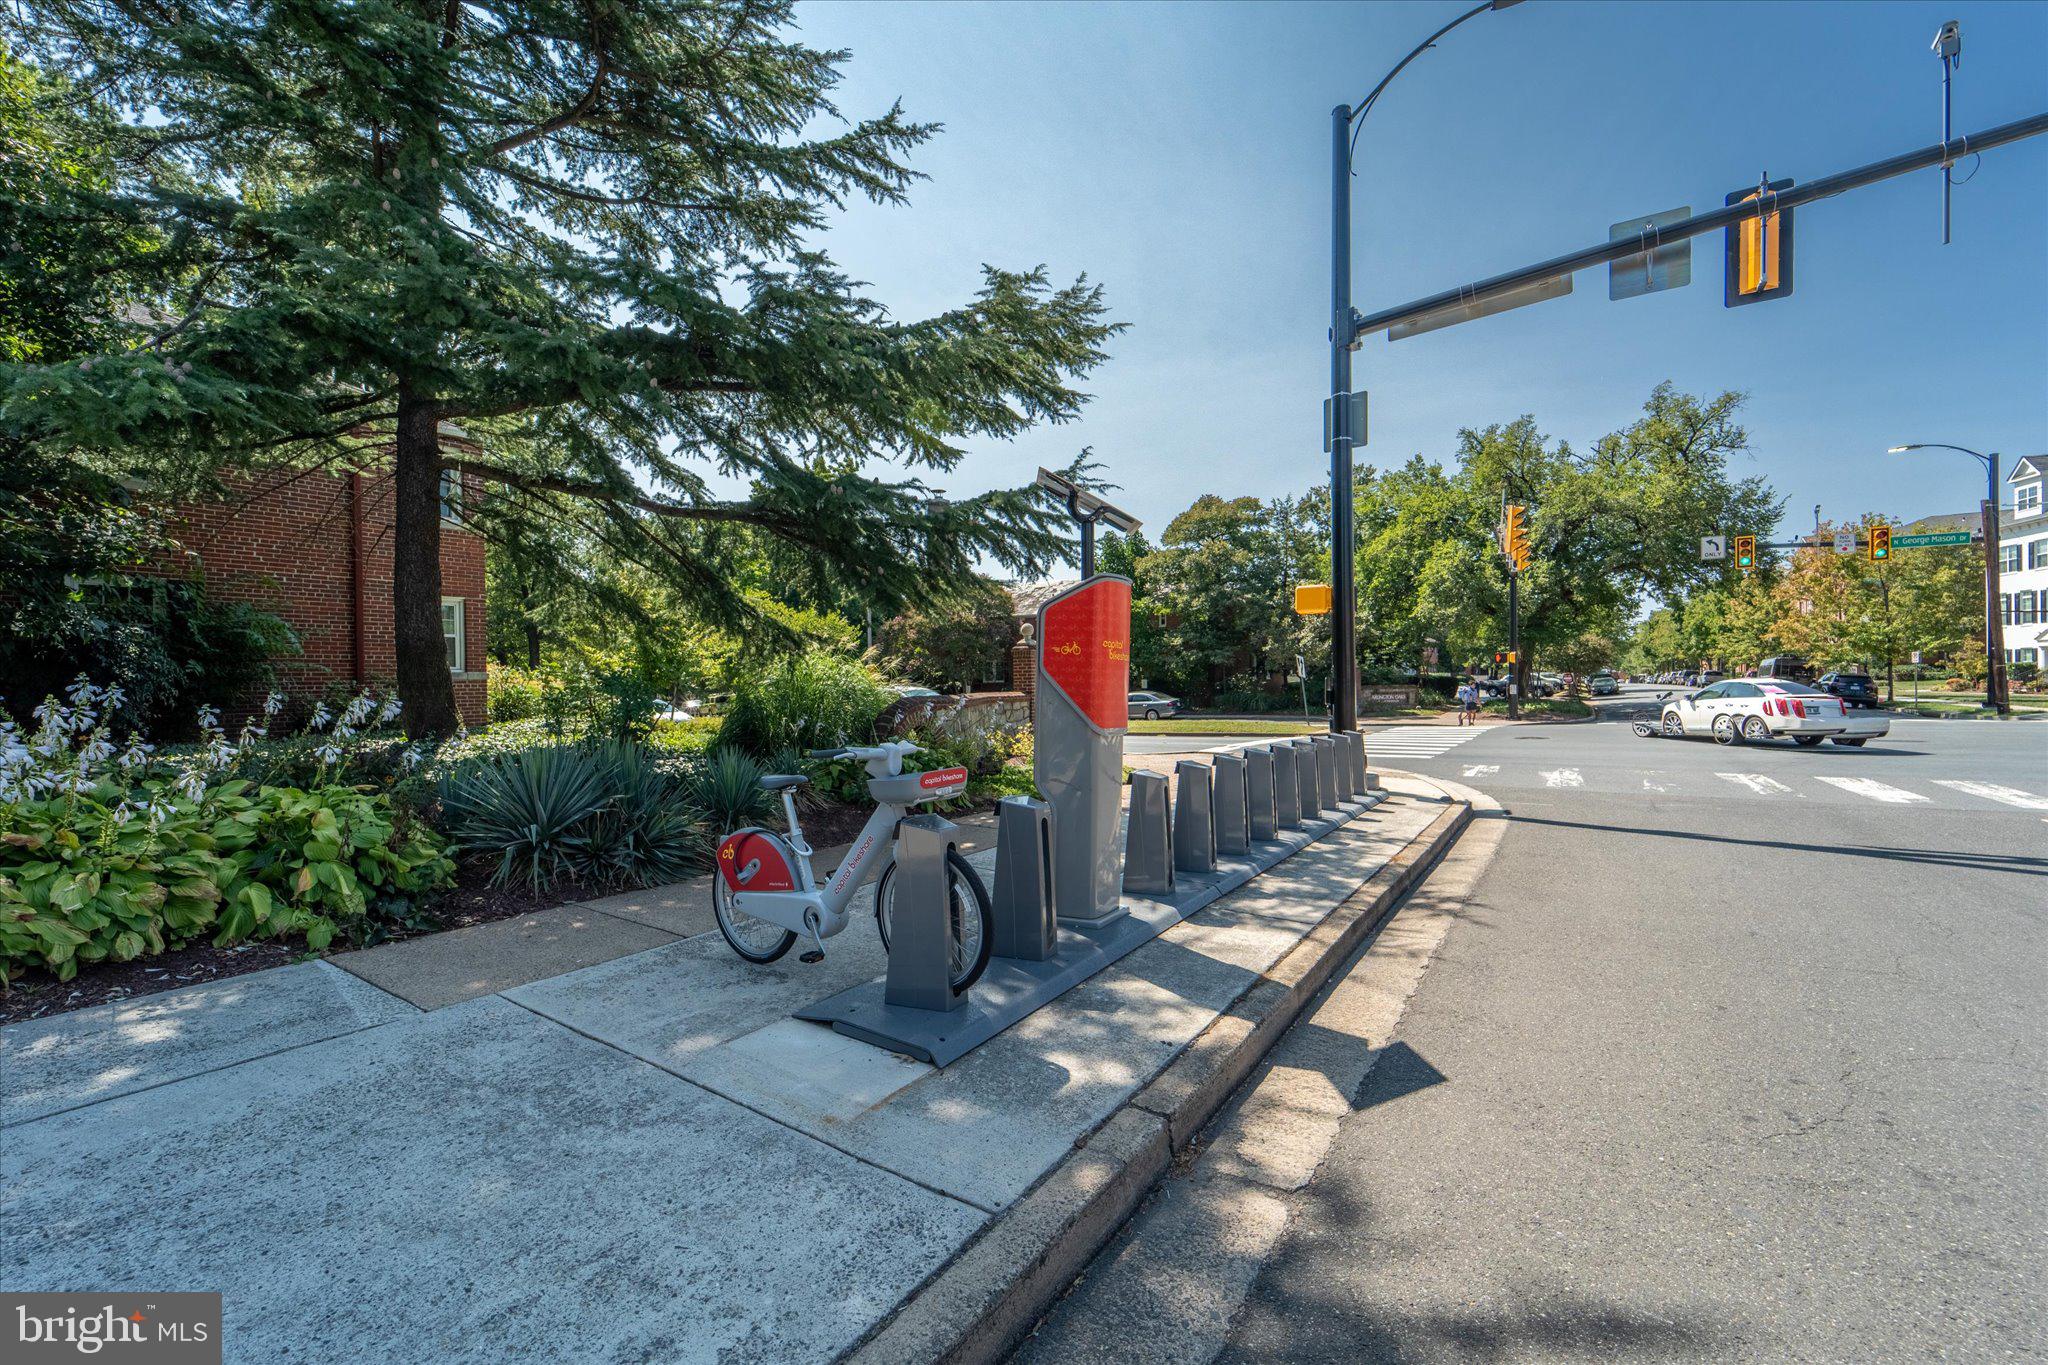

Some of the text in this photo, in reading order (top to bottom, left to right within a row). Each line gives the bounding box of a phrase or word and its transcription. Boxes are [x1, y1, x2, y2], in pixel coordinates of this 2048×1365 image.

[1902, 537, 1930, 545] George
[1102, 641, 1123, 650] capital
[924, 776, 941, 784] capital
[834, 836, 874, 894] capital bikeshare
